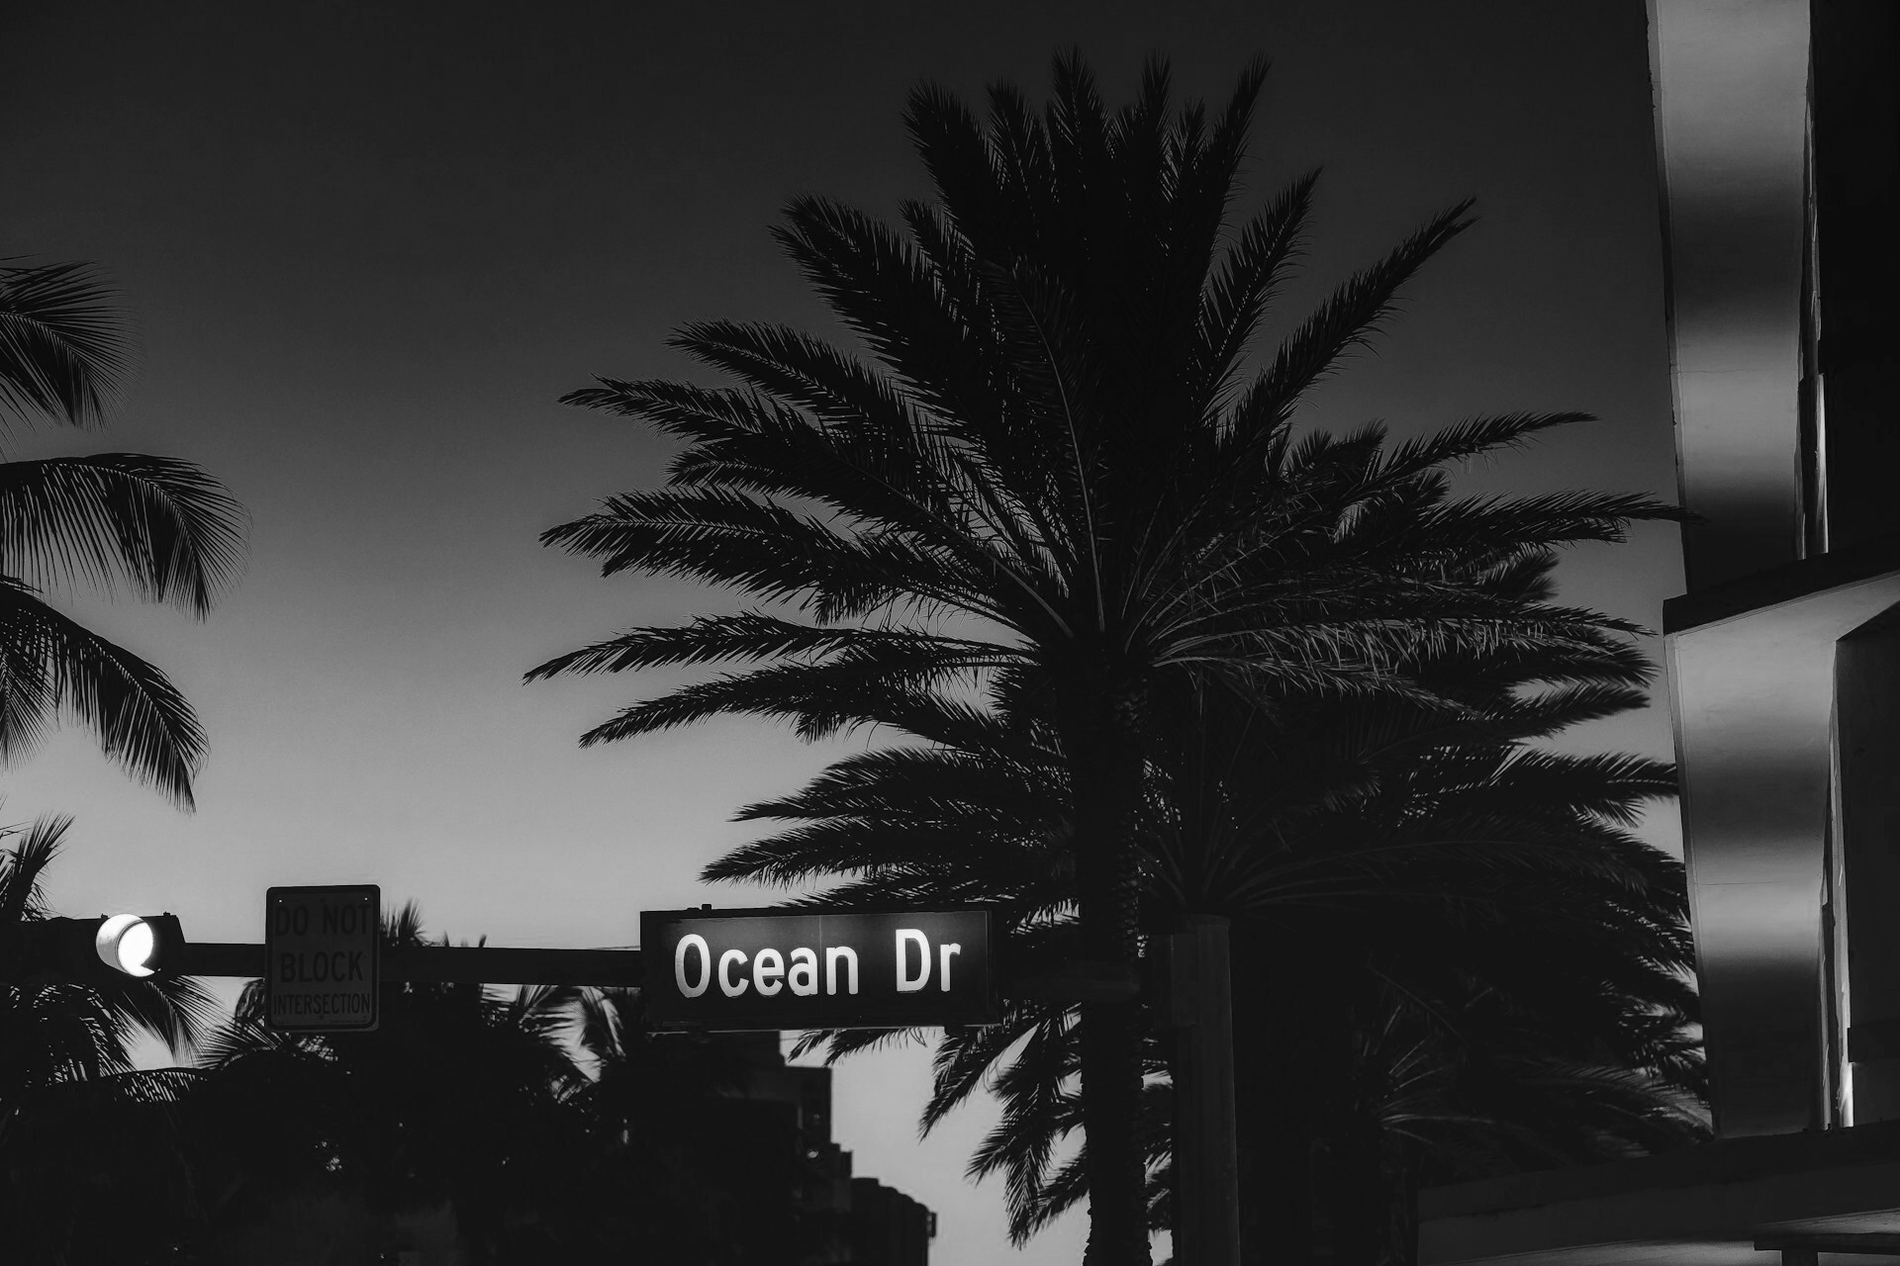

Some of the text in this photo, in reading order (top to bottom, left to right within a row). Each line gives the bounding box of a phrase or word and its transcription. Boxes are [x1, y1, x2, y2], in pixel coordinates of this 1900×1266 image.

[276, 905, 371, 935] DO NOT
[280, 950, 363, 983] BLOCK
[674, 928, 962, 998] Ocean Dr
[274, 993, 370, 1015] INTERSECTION
